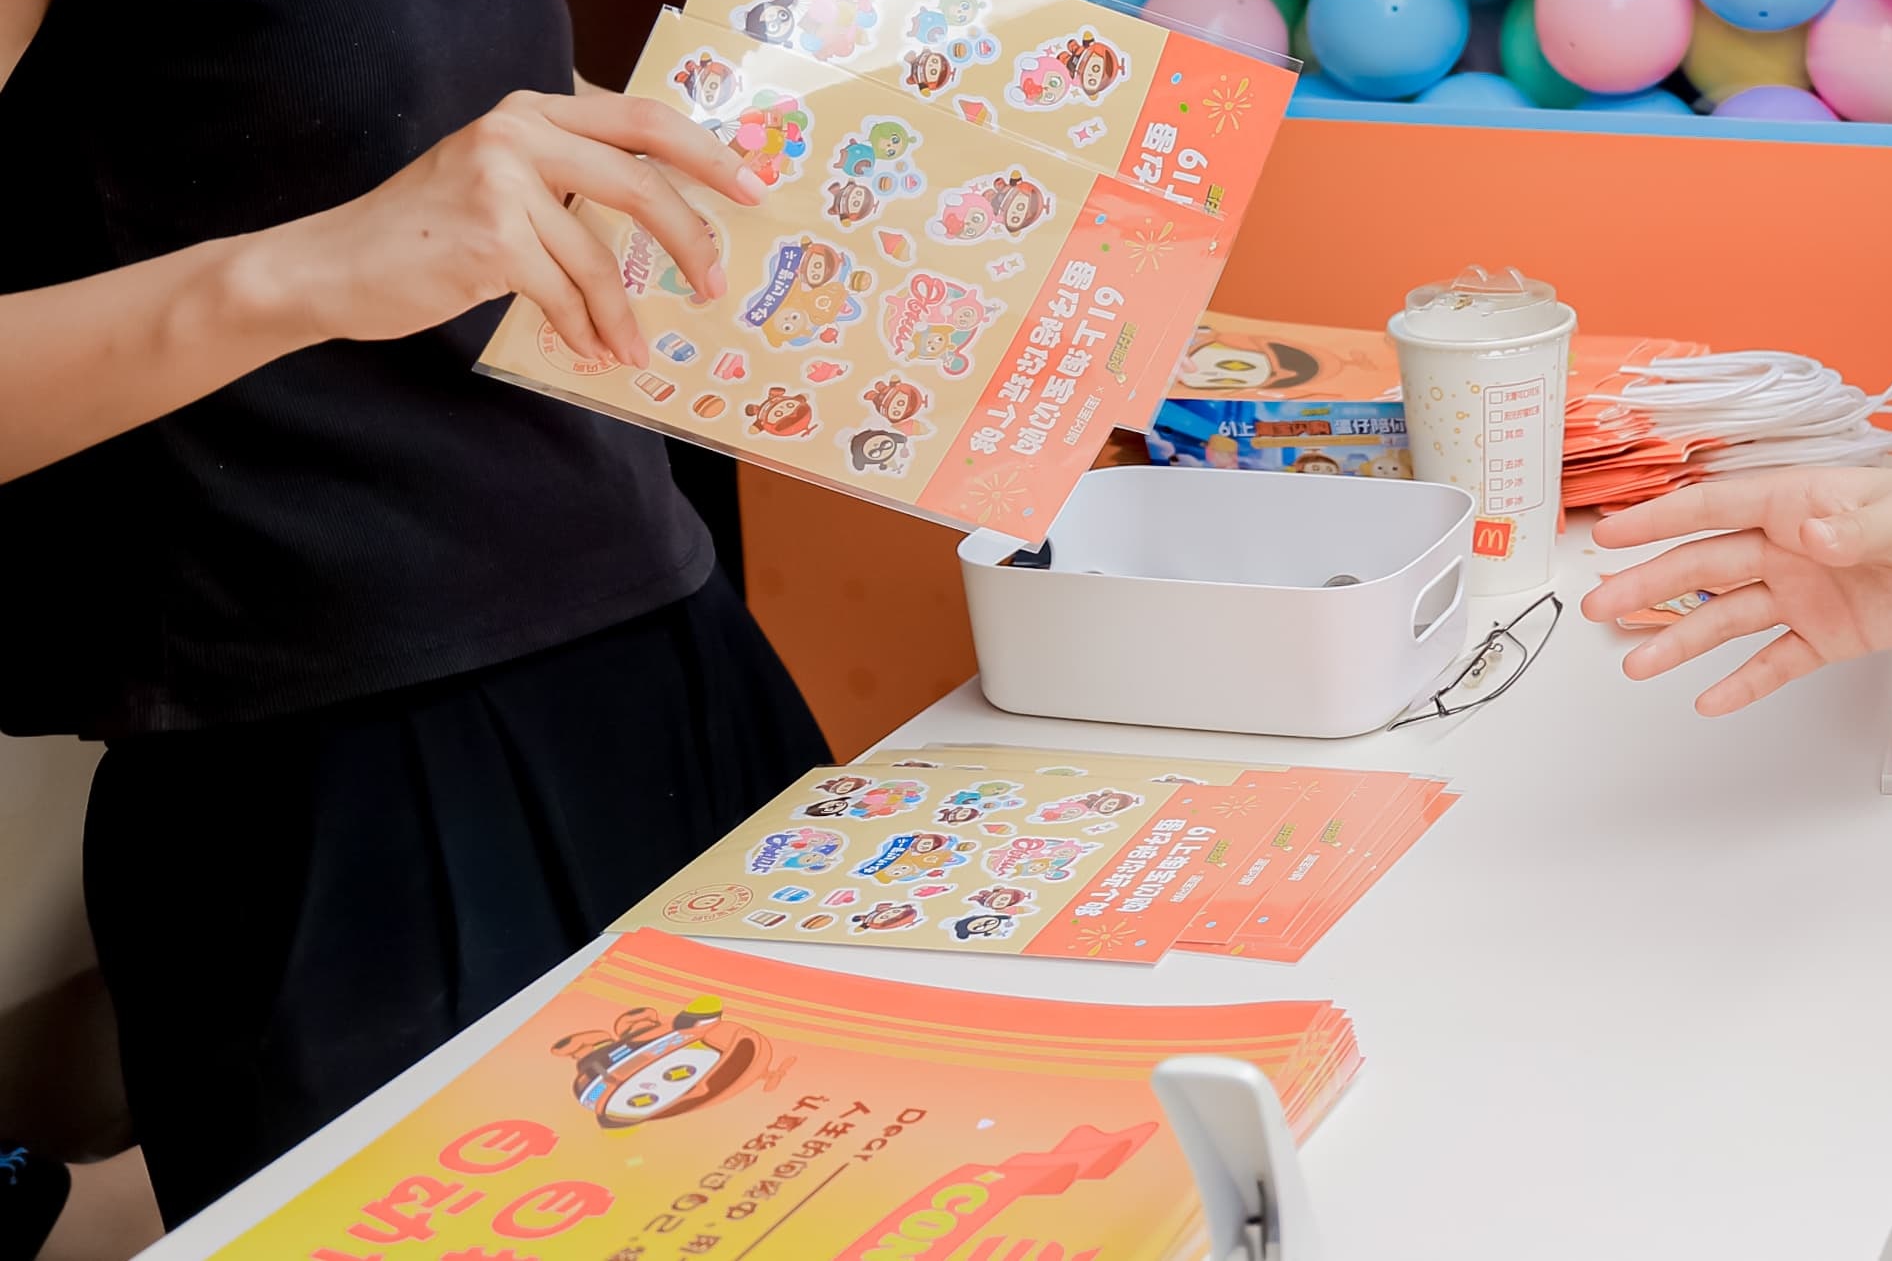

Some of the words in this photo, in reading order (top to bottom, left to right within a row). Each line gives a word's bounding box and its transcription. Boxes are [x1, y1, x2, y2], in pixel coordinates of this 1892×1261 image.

[969, 259, 1098, 454] 蛋仔陪你玩个够
[1010, 285, 1124, 456] 61上淘宝闪购
